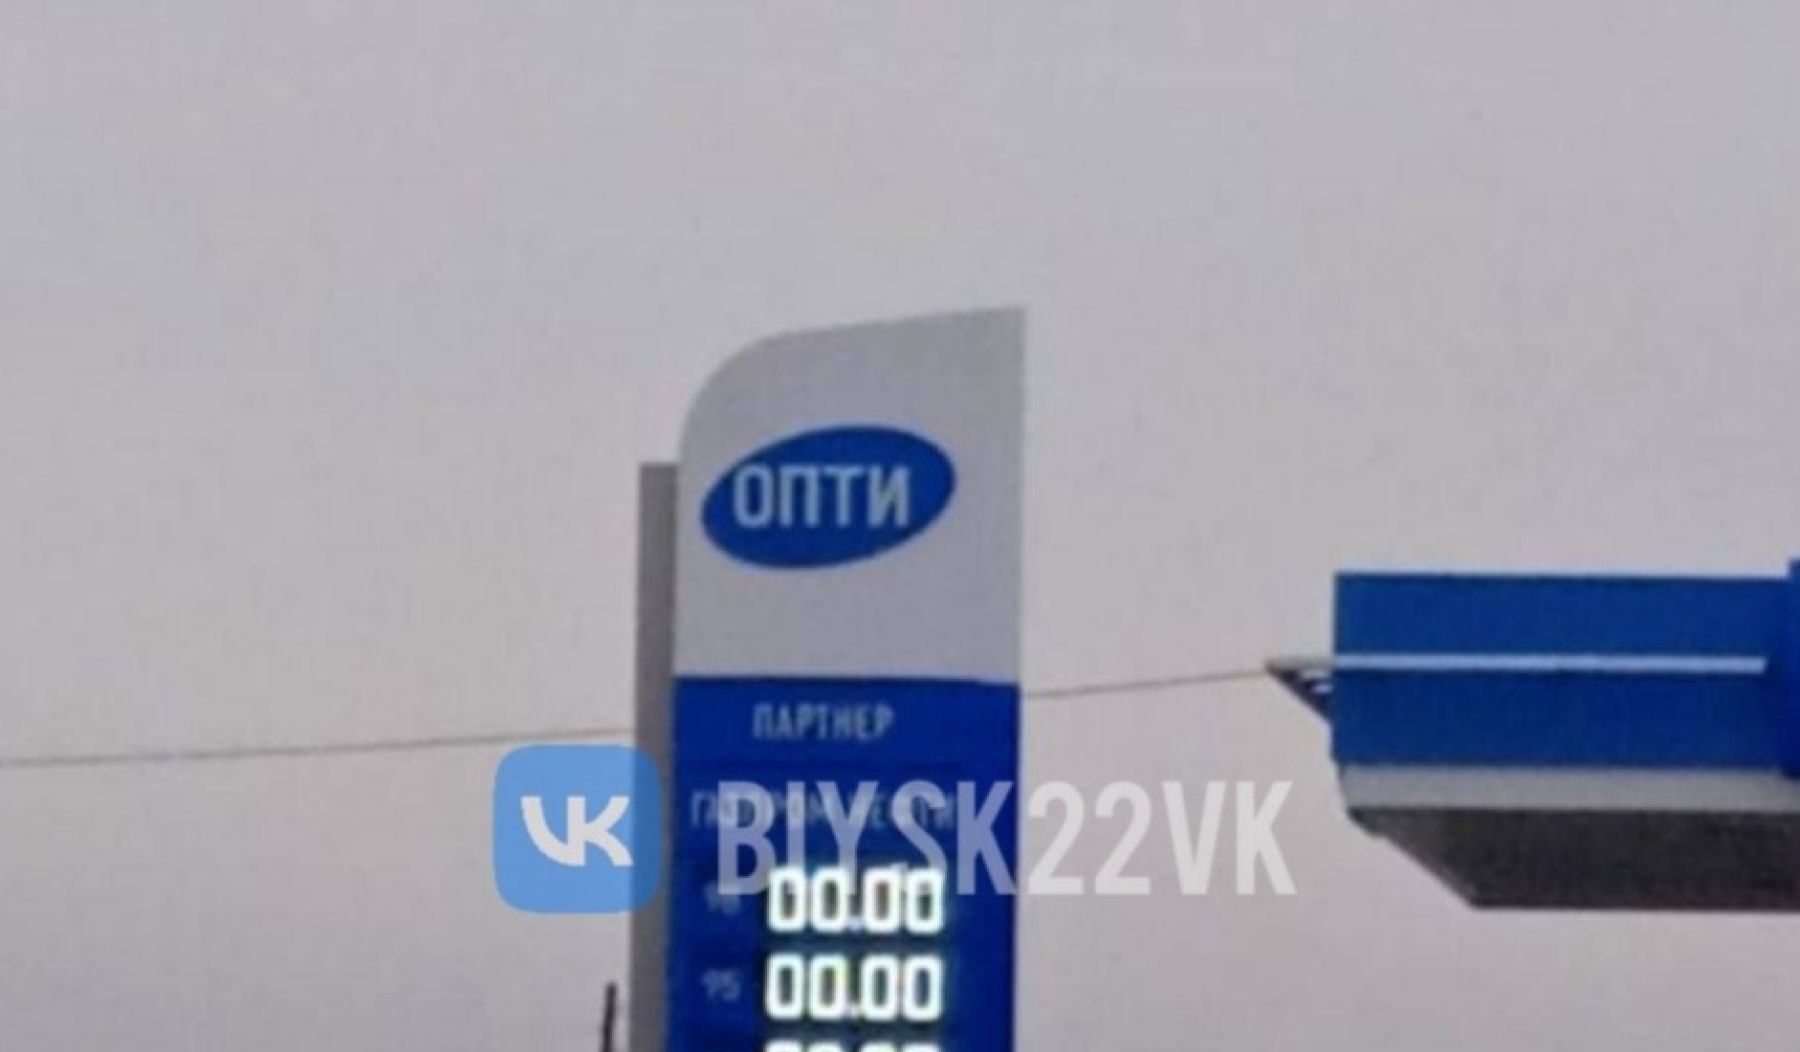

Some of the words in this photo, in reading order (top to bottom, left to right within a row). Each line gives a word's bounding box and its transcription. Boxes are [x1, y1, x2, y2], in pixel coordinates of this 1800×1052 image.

[733, 463, 910, 529] ОПТИ
[752, 703, 895, 739] ПАРТНЕР
[767, 866, 944, 934] 00.00
[703, 968, 741, 1001] 95
[764, 953, 943, 1022] 00.00
